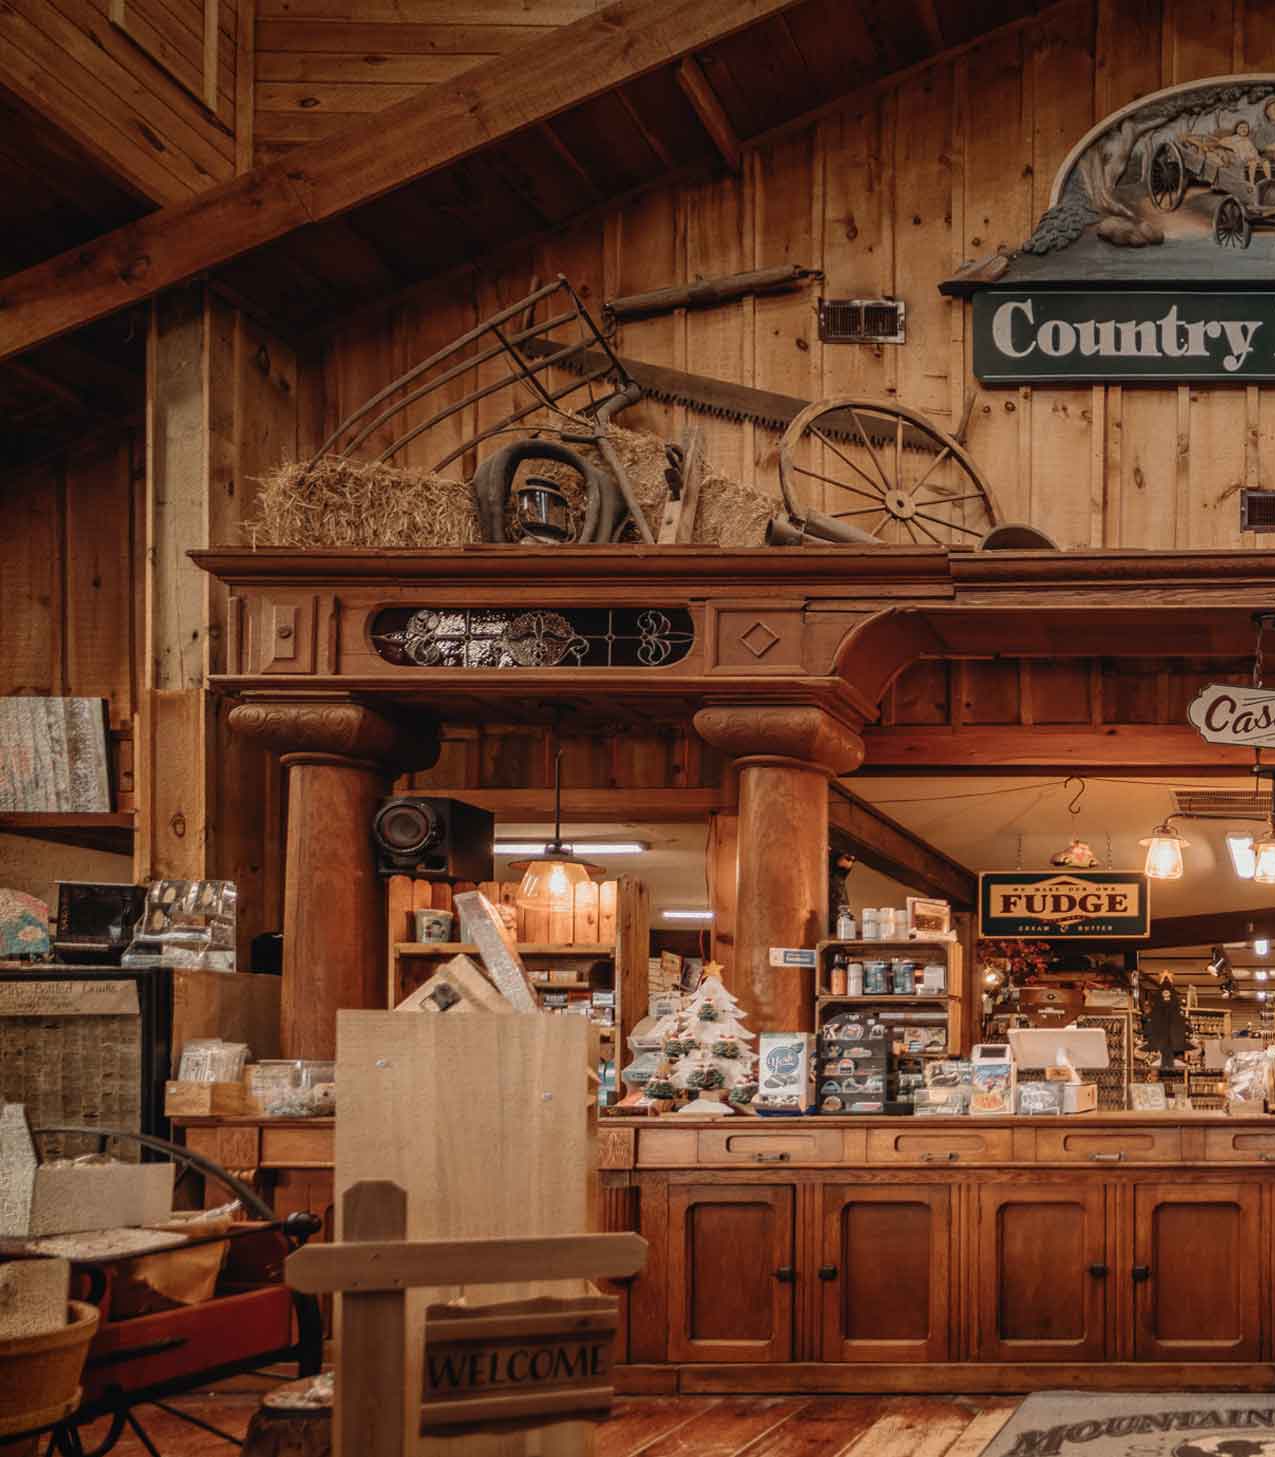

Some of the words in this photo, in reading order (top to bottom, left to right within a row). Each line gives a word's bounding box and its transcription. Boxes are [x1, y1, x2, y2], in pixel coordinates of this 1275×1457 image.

[991, 298, 1263, 372] Country
[1000, 893, 1128, 914] FUDGE
[428, 1345, 607, 1388] WELCOME
